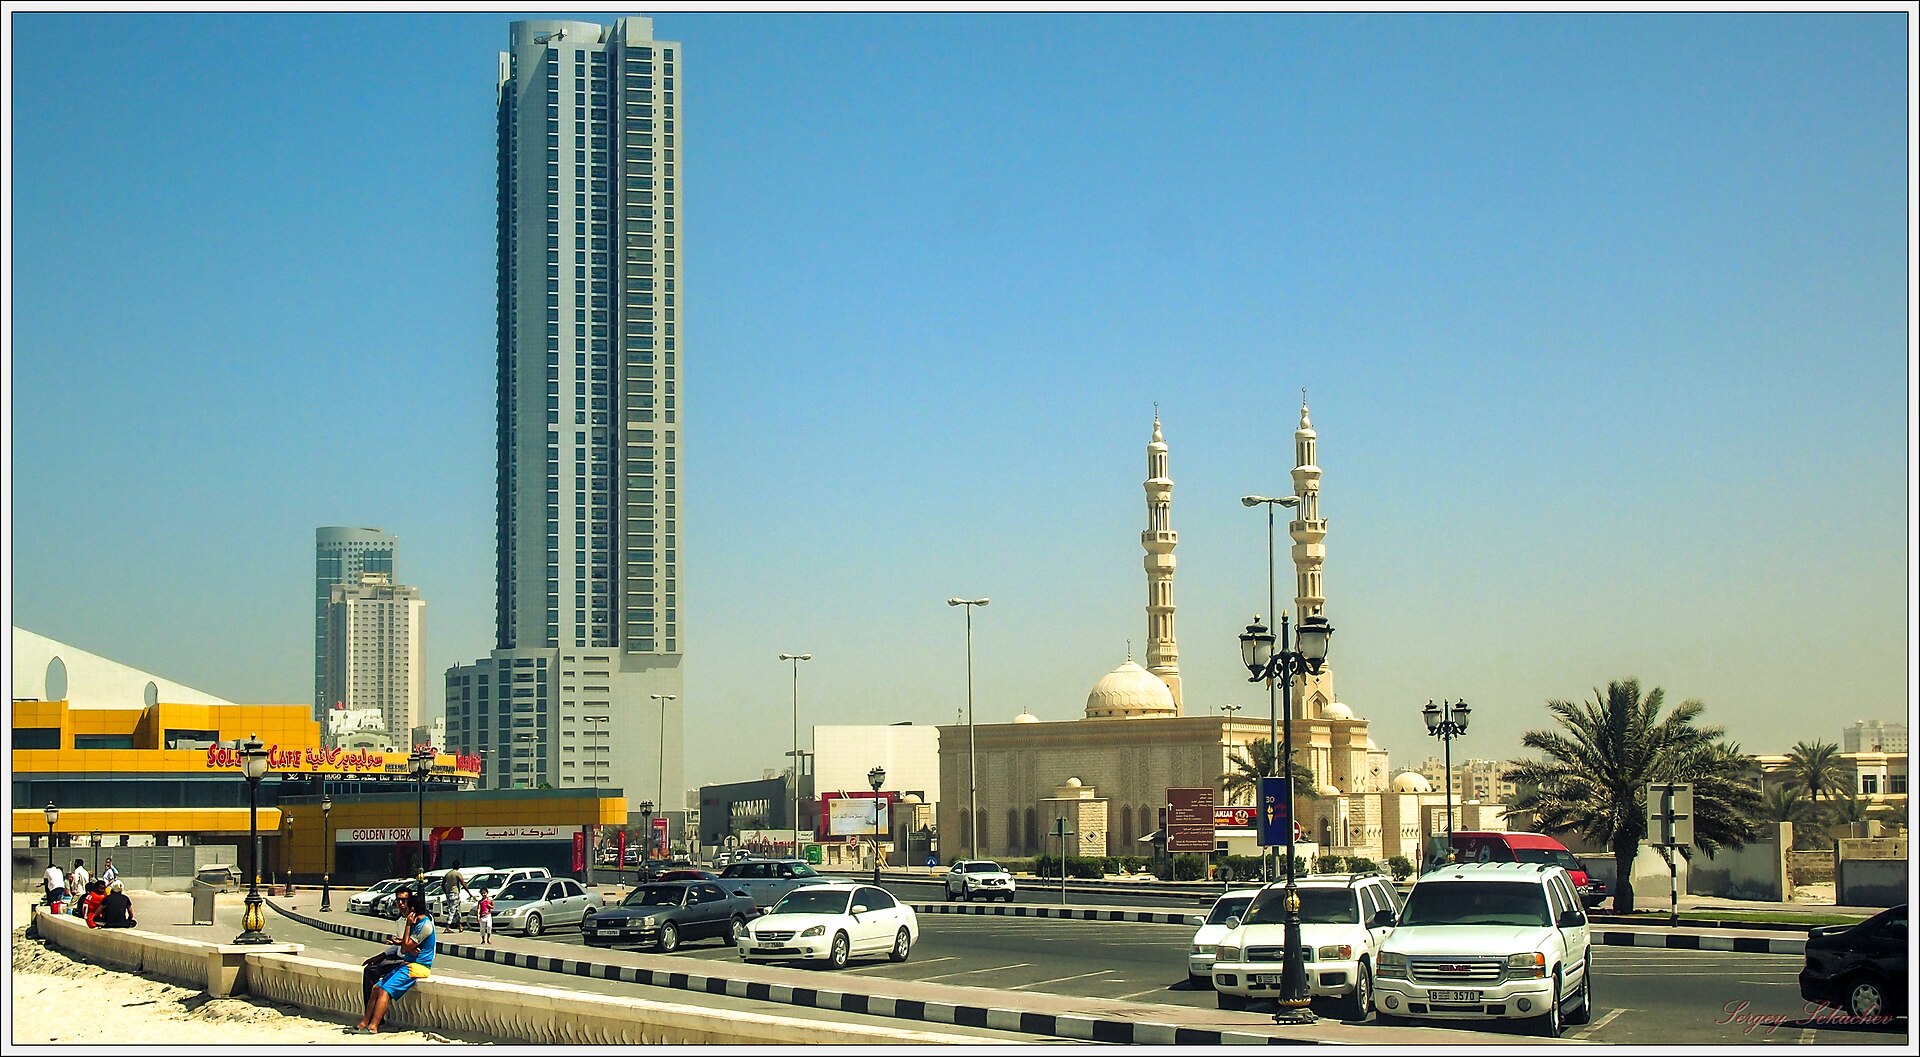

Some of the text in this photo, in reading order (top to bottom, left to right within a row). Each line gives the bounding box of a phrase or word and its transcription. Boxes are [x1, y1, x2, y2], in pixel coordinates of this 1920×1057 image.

[269, 743, 302, 768] CAFE
[1265, 795, 1275, 804] 30
[352, 828, 412, 841] GOLDEN FORK
[485, 827, 559, 839] الشوكة الذهبية
[1439, 964, 1472, 972] GMC
[1432, 991, 1438, 1000] B
[1453, 991, 1475, 1001] 3570
